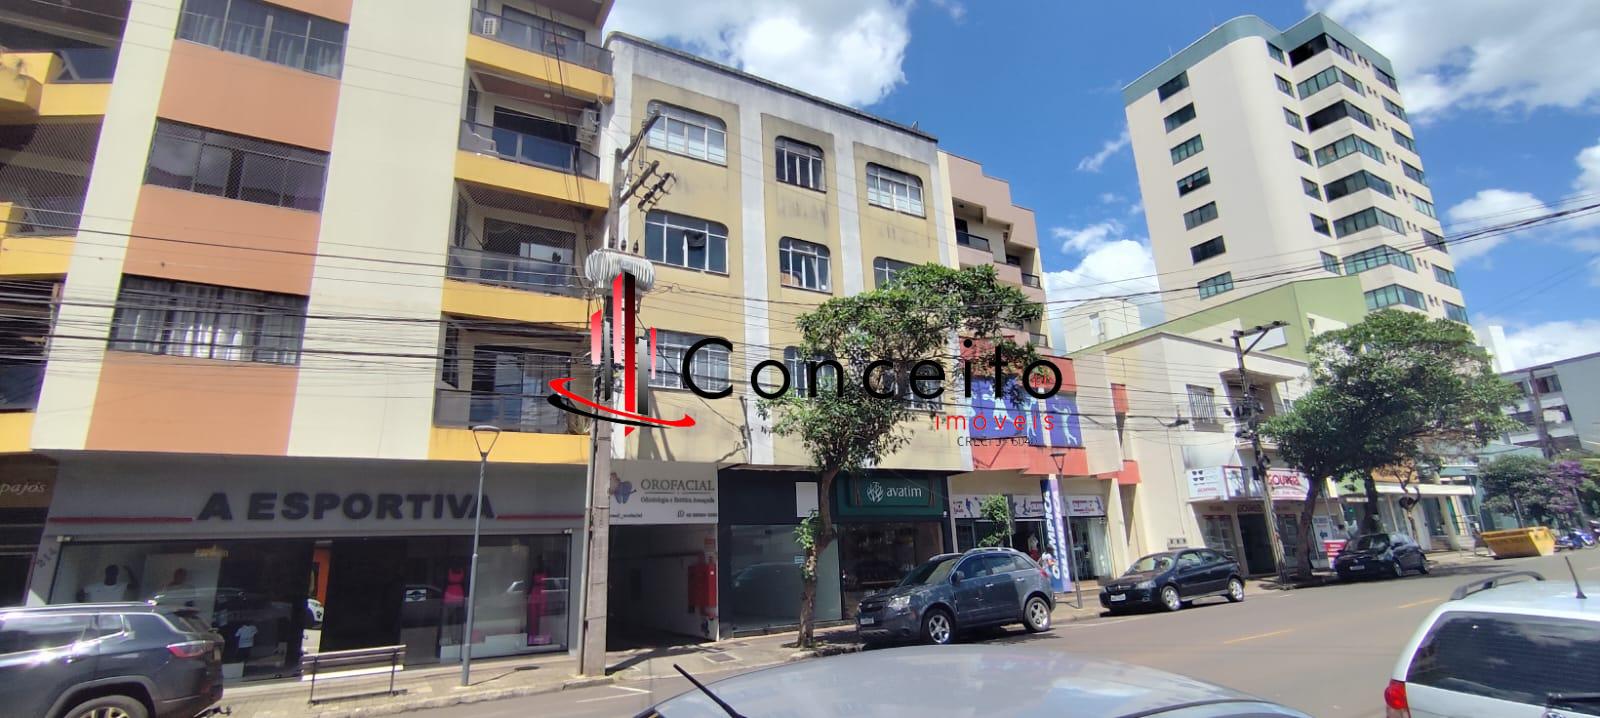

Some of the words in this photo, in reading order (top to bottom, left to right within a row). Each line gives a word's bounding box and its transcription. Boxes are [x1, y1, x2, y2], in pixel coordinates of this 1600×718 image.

[640, 478, 715, 491] OROFACIAL
[886, 486, 922, 497] avatim
[196, 491, 233, 521] A
[247, 491, 495, 521] ESPORTIVA
